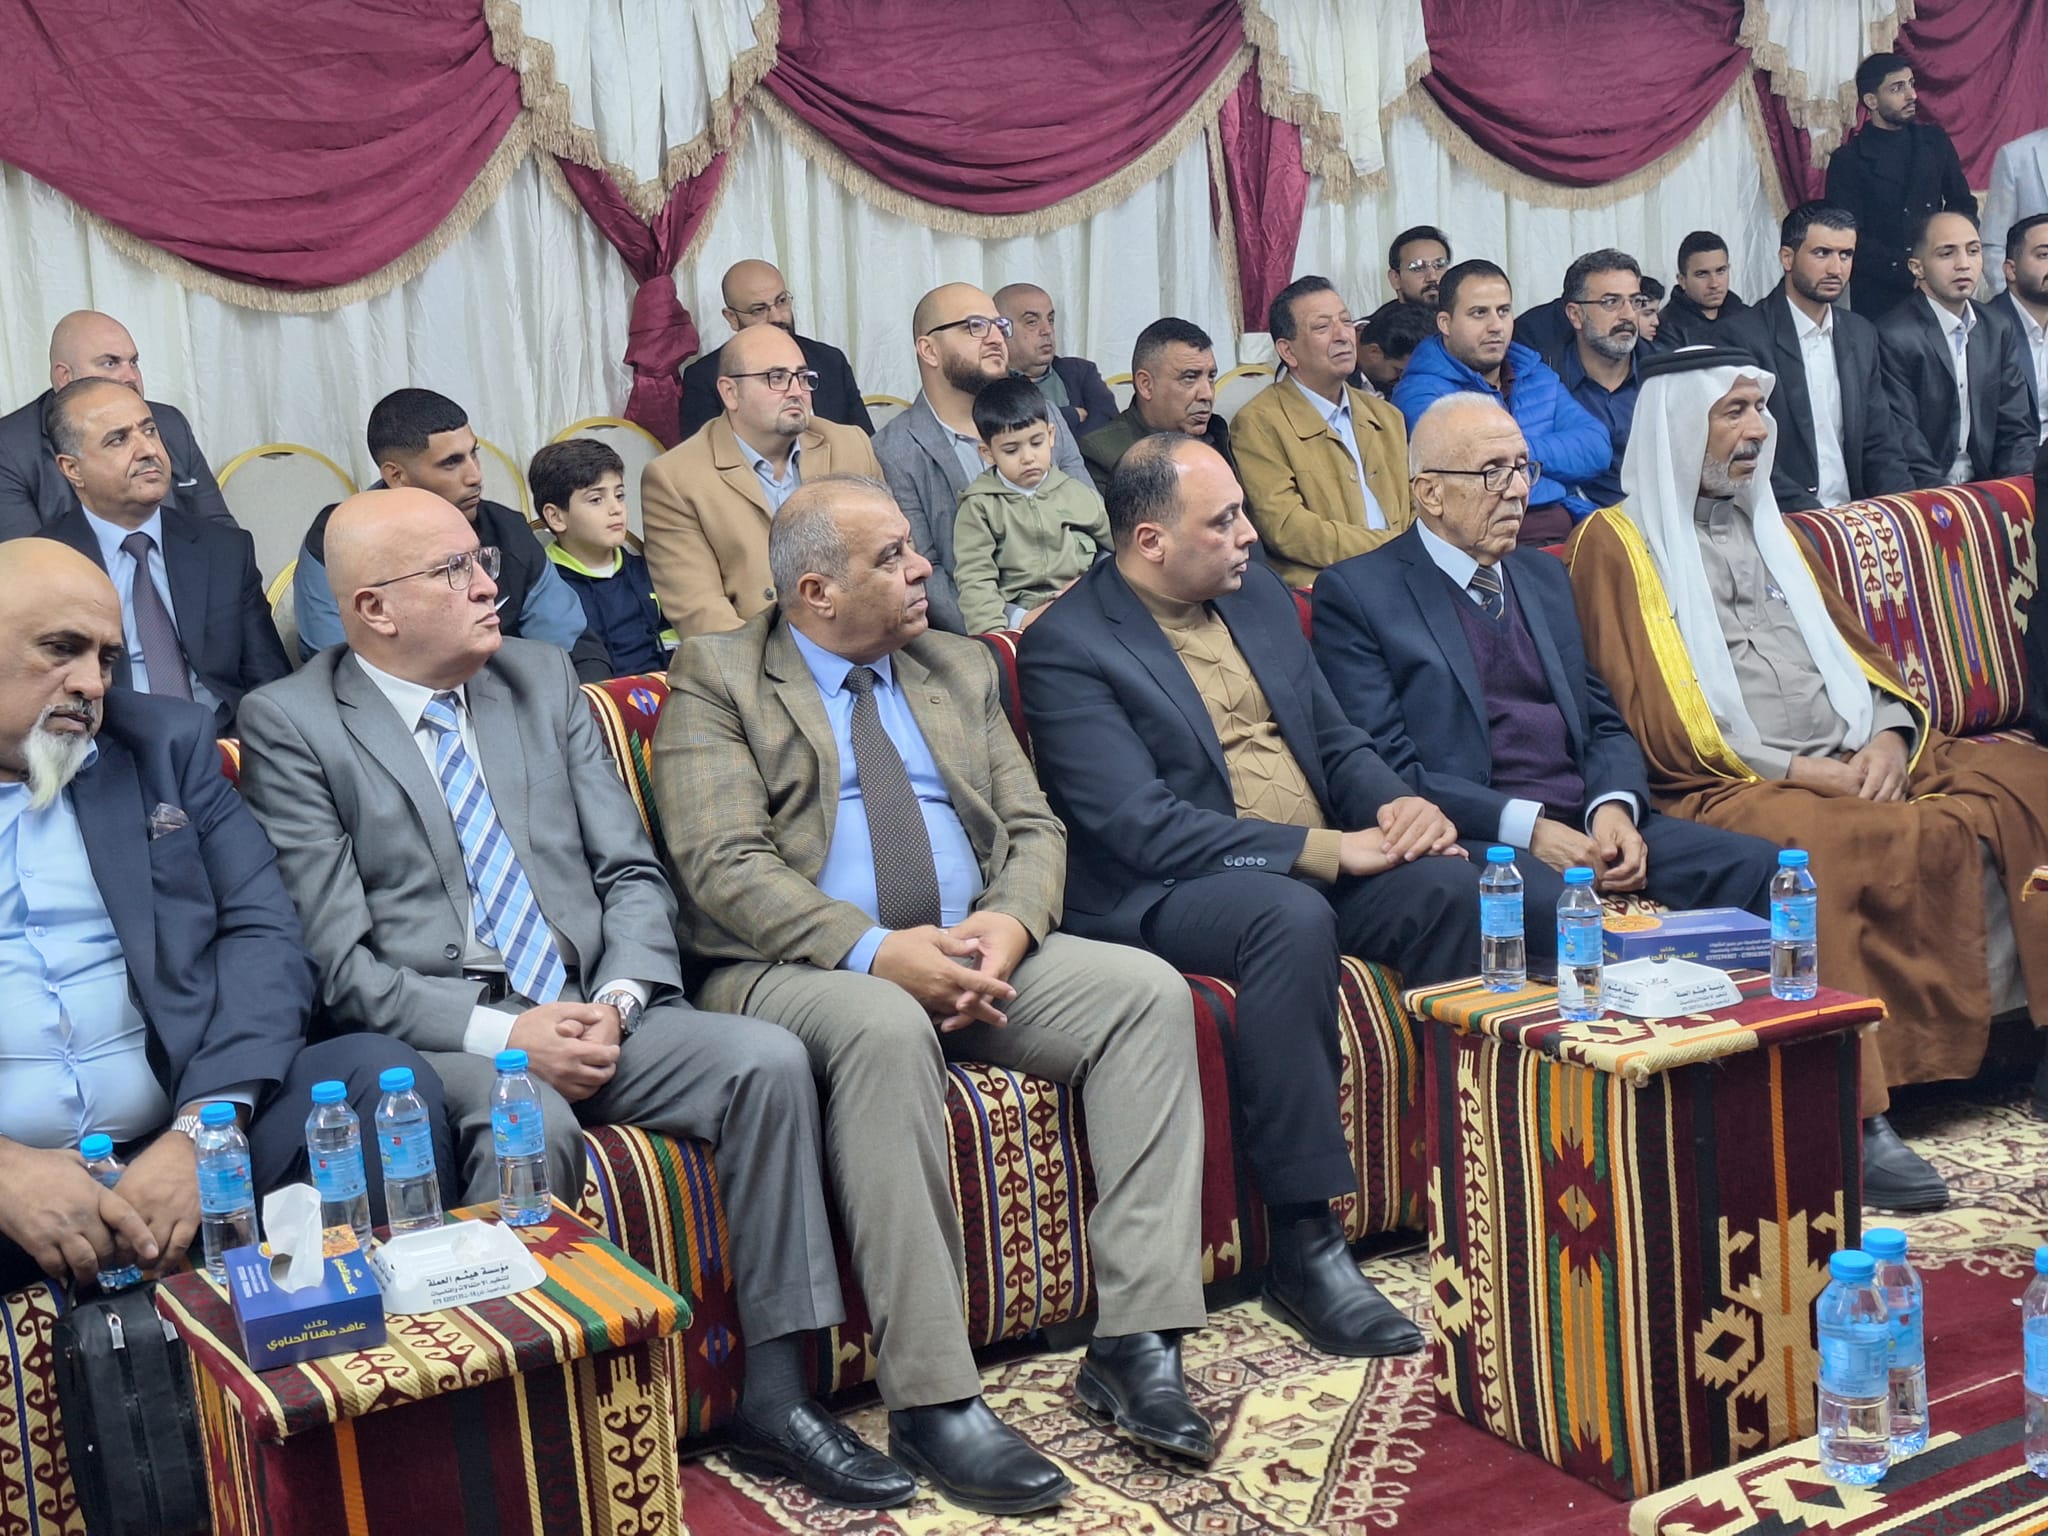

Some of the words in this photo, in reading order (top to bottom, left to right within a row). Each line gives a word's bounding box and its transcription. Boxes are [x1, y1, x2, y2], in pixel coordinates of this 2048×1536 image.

[480, 1263, 509, 1275] مؤسسة
[455, 1269, 479, 1283] هيثم
[304, 1319, 328, 1330] مكتب
[339, 1322, 366, 1334] عاهد
[310, 1329, 336, 1340] مهنا
